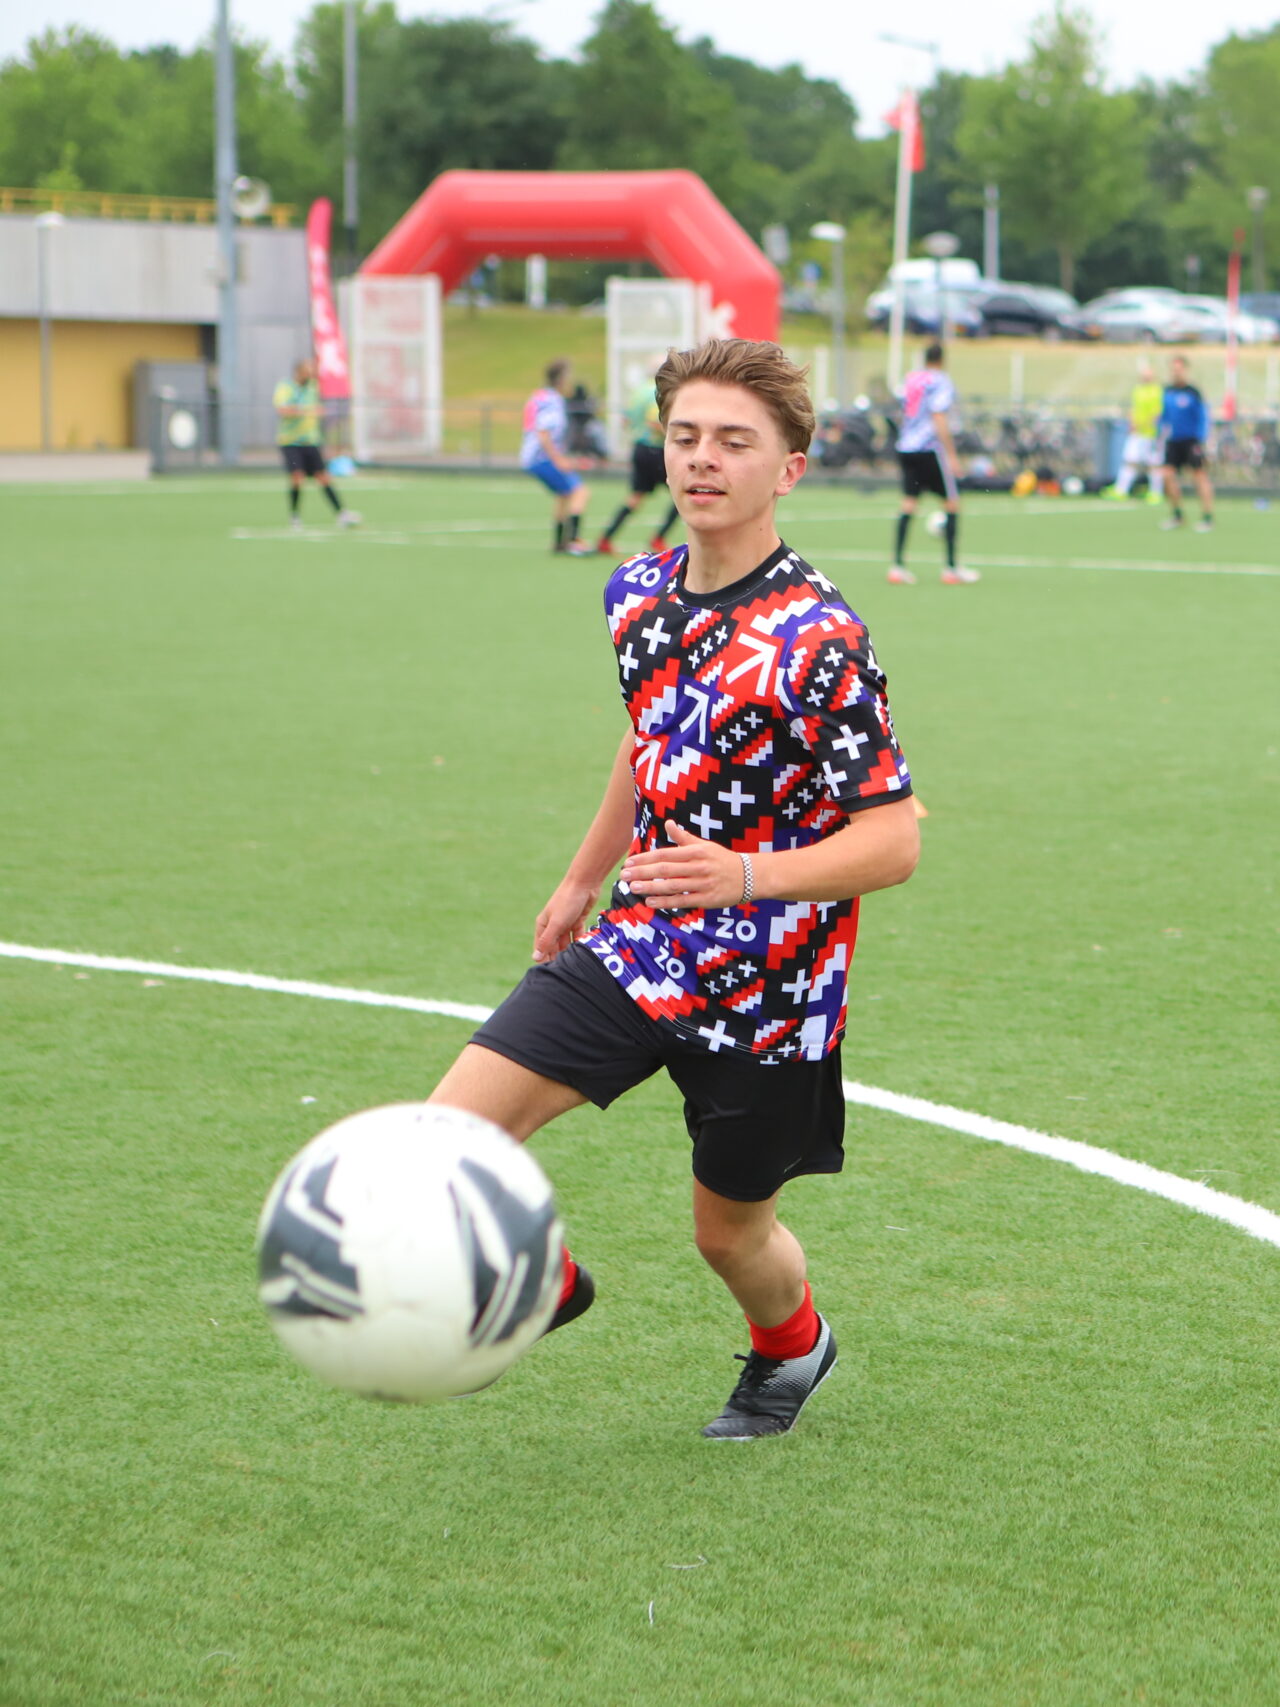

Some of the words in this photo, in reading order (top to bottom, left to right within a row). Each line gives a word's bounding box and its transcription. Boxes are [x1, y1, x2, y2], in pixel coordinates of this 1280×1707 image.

[715, 916, 758, 942] ZO
[591, 940, 624, 978] ZO
[654, 945, 686, 979] ZO
